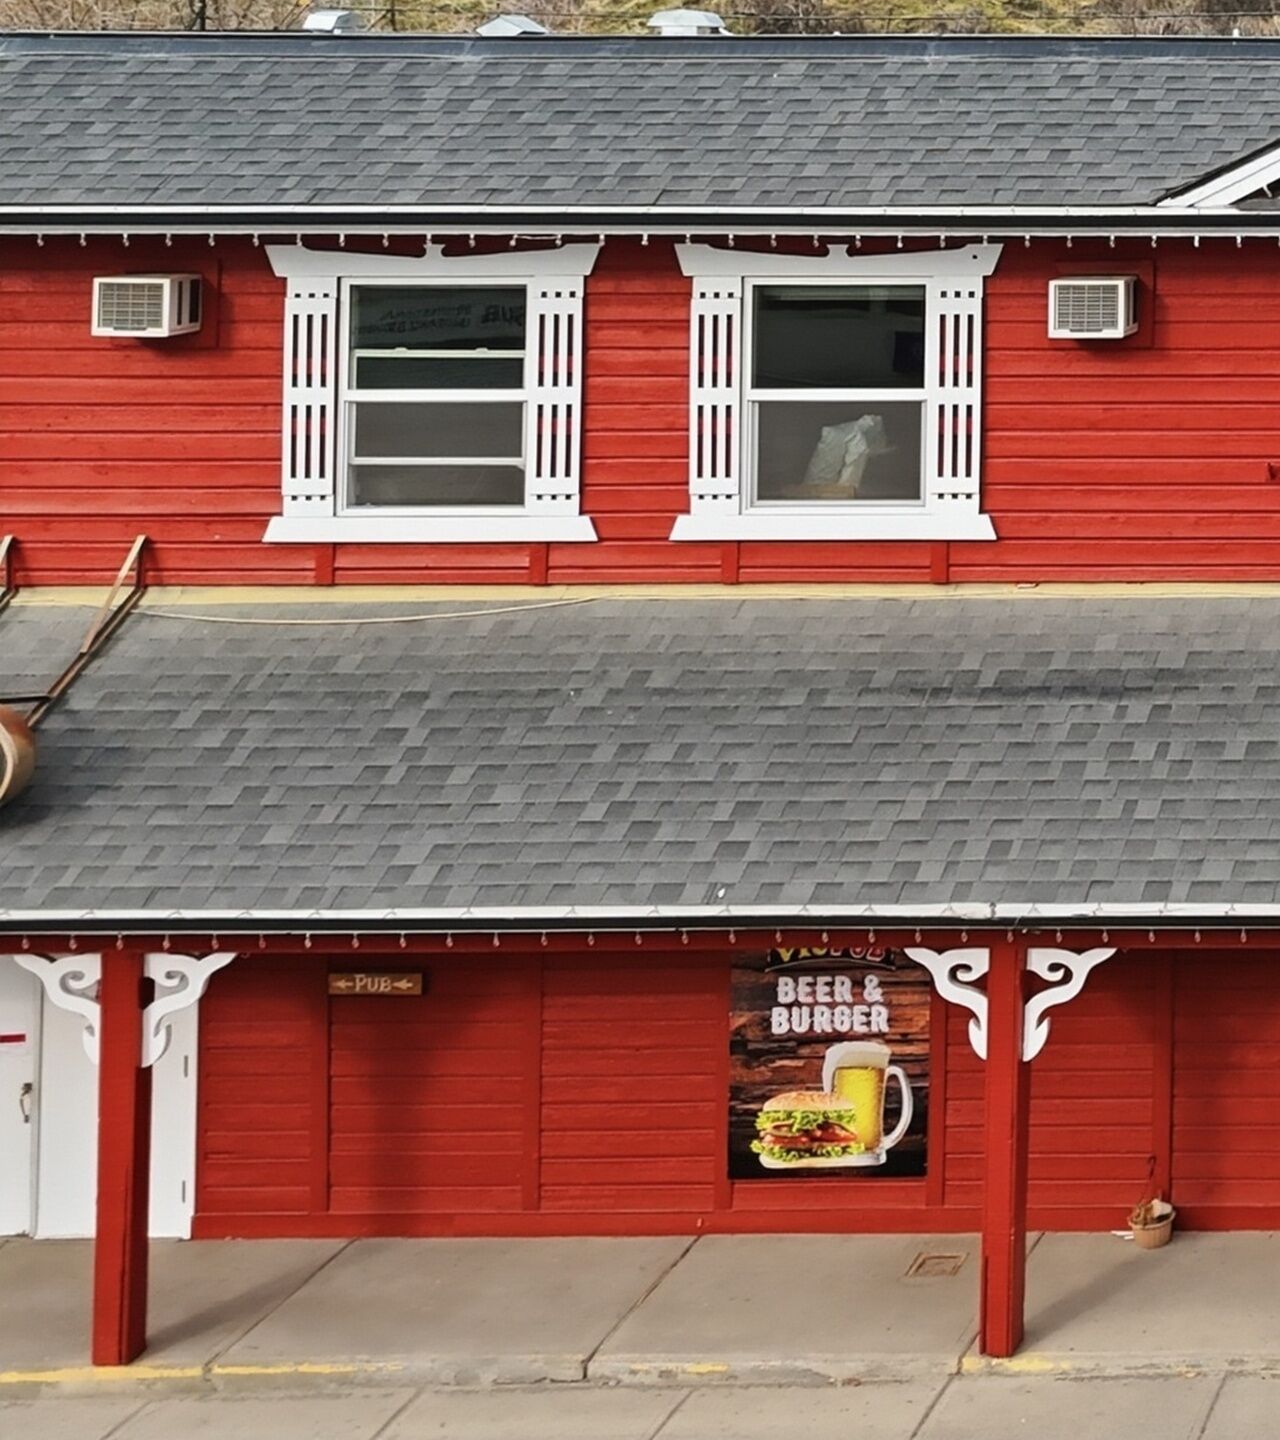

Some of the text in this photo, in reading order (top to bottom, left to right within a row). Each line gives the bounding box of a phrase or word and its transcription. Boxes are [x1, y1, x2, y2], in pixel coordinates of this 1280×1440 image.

[354, 973, 392, 992] PUB
[776, 974, 884, 1004] BEER &
[771, 1005, 889, 1035] BURGER
